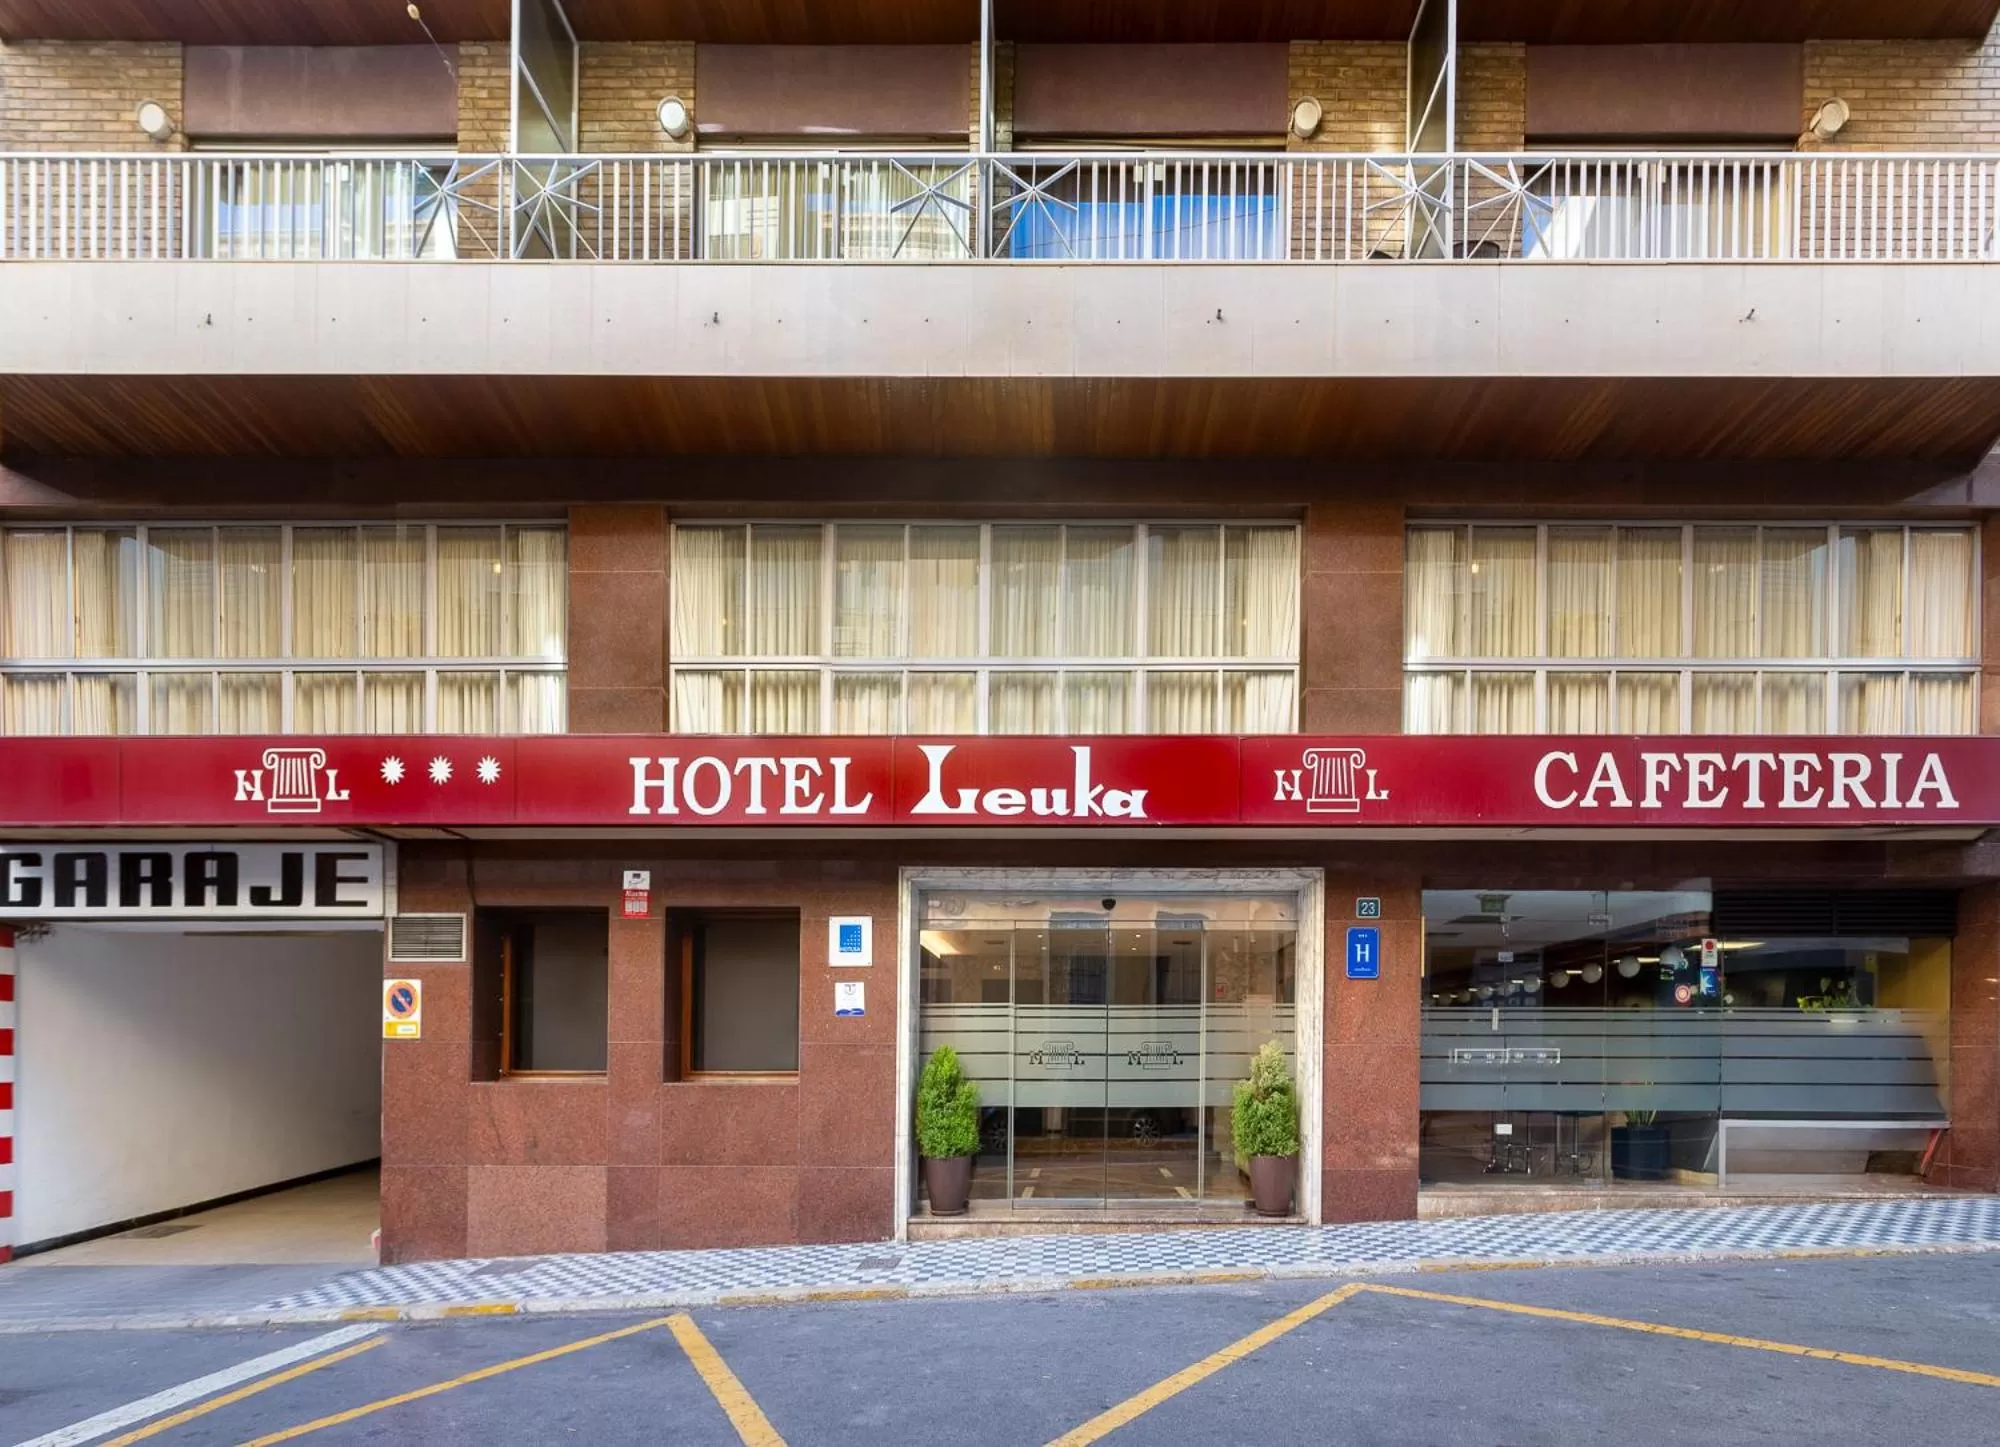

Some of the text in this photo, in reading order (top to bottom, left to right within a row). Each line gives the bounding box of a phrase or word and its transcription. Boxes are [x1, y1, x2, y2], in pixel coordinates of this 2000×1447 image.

[628, 744, 1149, 819] HOTEL Leuka
[1533, 750, 1960, 809] CAFETERIA
[0, 851, 370, 908] GARAJE
[1360, 901, 1376, 915] 23
[1355, 943, 1370, 963] H
